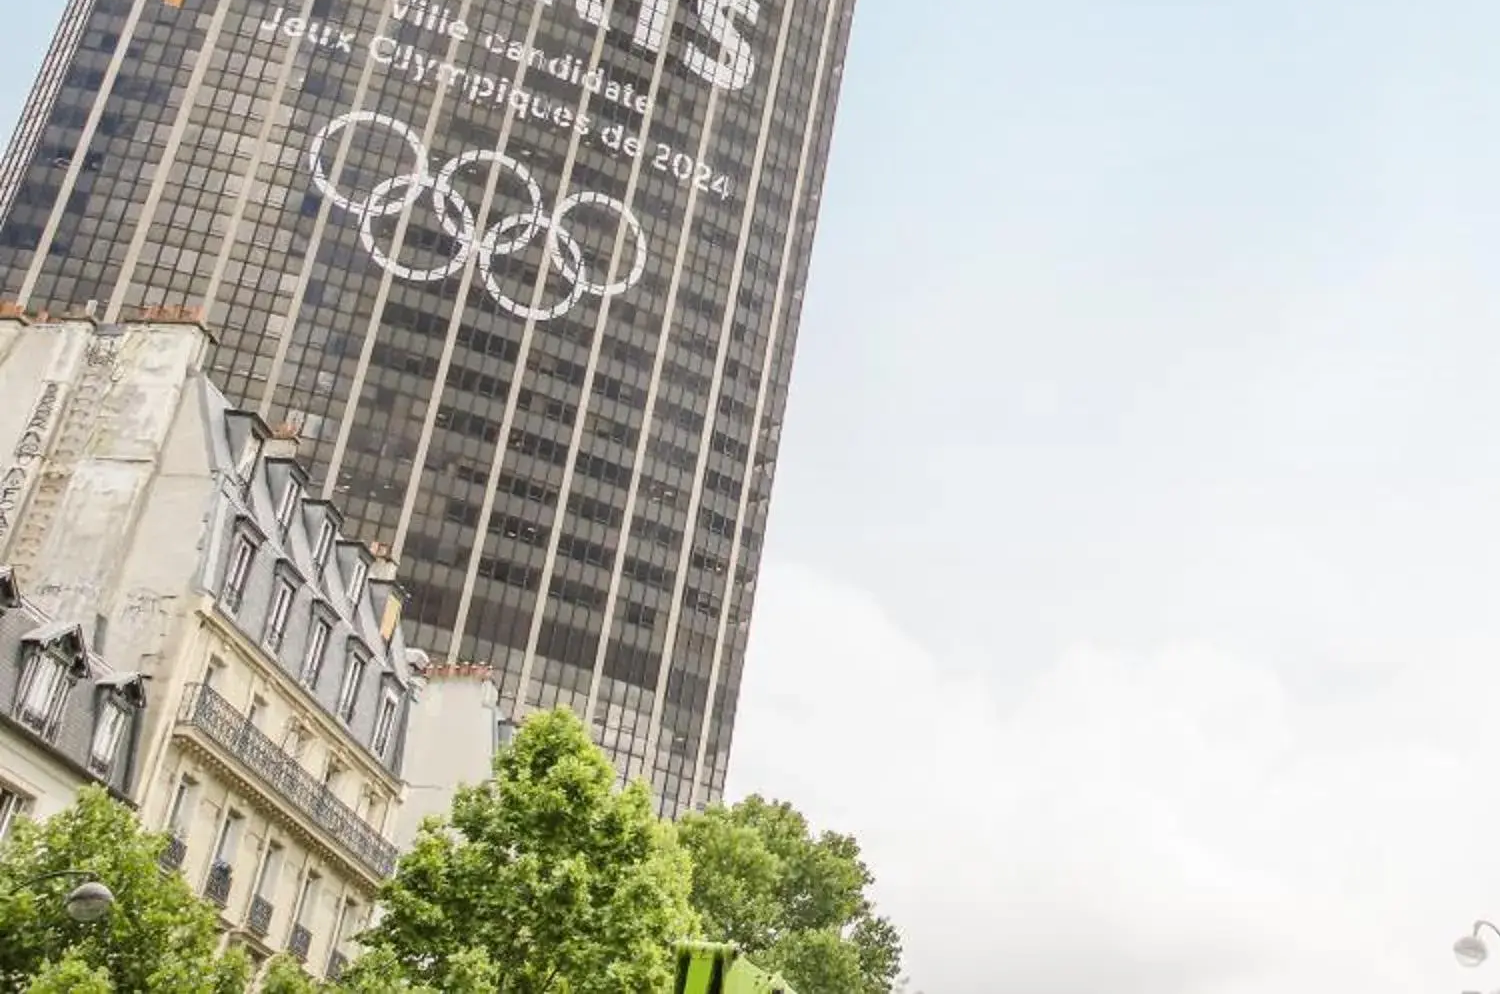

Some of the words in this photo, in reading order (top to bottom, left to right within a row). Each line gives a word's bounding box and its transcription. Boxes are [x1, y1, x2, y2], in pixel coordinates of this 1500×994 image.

[261, 7, 355, 53] Jeux
[601, 125, 643, 157] de
[651, 143, 733, 200] 2024
[484, 32, 655, 114] candidate
